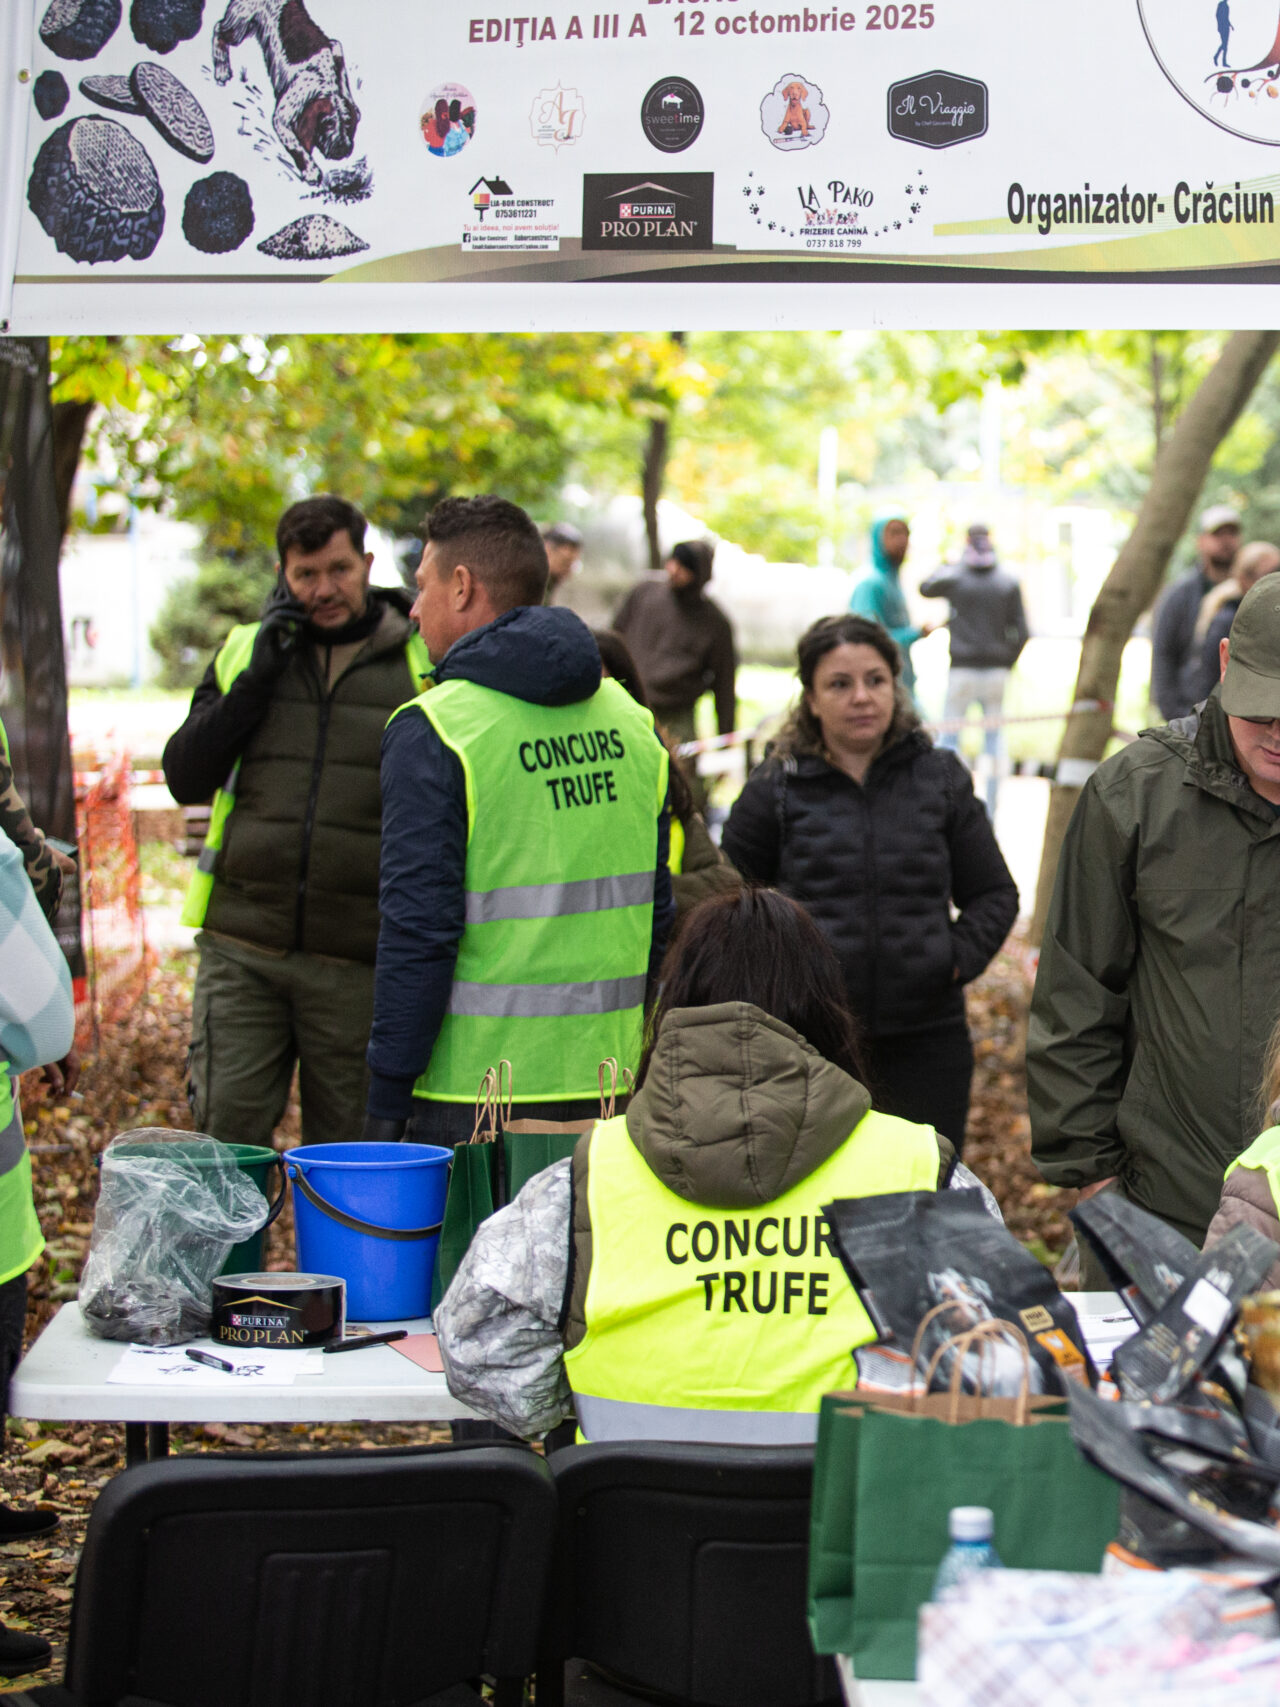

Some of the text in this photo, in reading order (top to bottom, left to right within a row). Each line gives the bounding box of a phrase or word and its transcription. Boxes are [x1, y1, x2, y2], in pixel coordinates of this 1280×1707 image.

[565, 15, 583, 39] A
[593, 14, 619, 38] III
[628, 13, 647, 37] A
[674, 11, 705, 36] 12
[715, 7, 856, 35] octombrie
[865, 4, 935, 30] 2025
[919, 91, 976, 126] Viaggio
[516, 199, 554, 207] CONSTRUCT
[632, 206, 673, 215] PURINA
[797, 184, 821, 214] LA
[1007, 182, 1165, 235] Organizator-
[1173, 181, 1274, 224] Crăciun
[600, 221, 695, 237] PRO PLAN
[806, 239, 861, 247] 0737 818 799
[519, 728, 625, 773] CONCURS
[546, 770, 618, 810] TRUFE
[665, 1214, 840, 1265] CONCUR
[696, 1270, 830, 1316] TRUFE
[219, 1325, 306, 1344] PRO PLAN
[241, 1316, 284, 1327] PURINA
